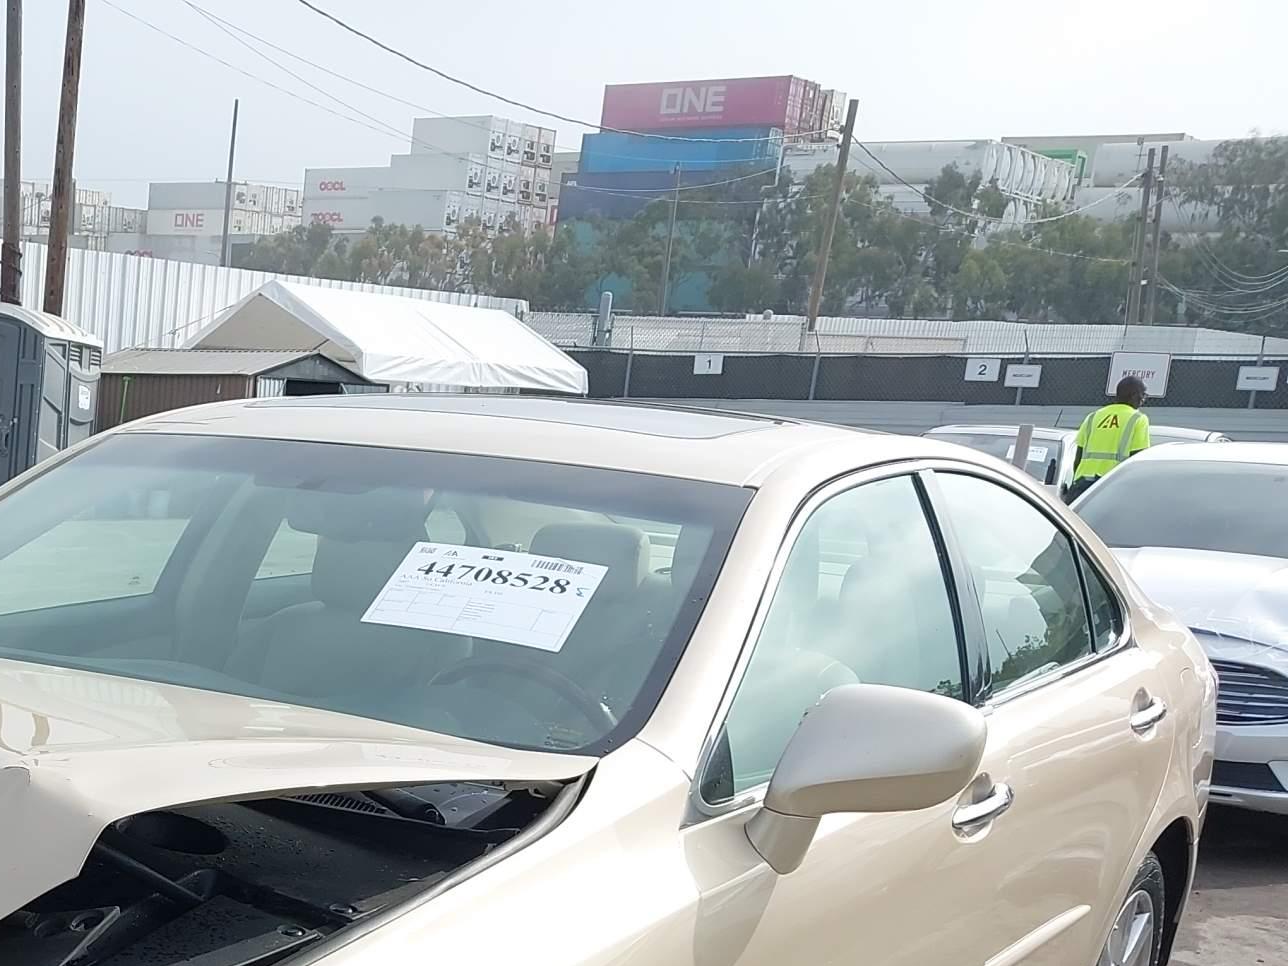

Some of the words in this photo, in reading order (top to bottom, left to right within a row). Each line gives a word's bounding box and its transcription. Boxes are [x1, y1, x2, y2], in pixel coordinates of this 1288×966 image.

[659, 86, 727, 114] ONE
[319, 181, 346, 191] OOCL
[174, 213, 204, 228] ONE
[706, 359, 712, 369] 1
[978, 364, 988, 376] 2
[1122, 369, 1156, 379] MERCURY
[417, 560, 572, 594] 44708528
